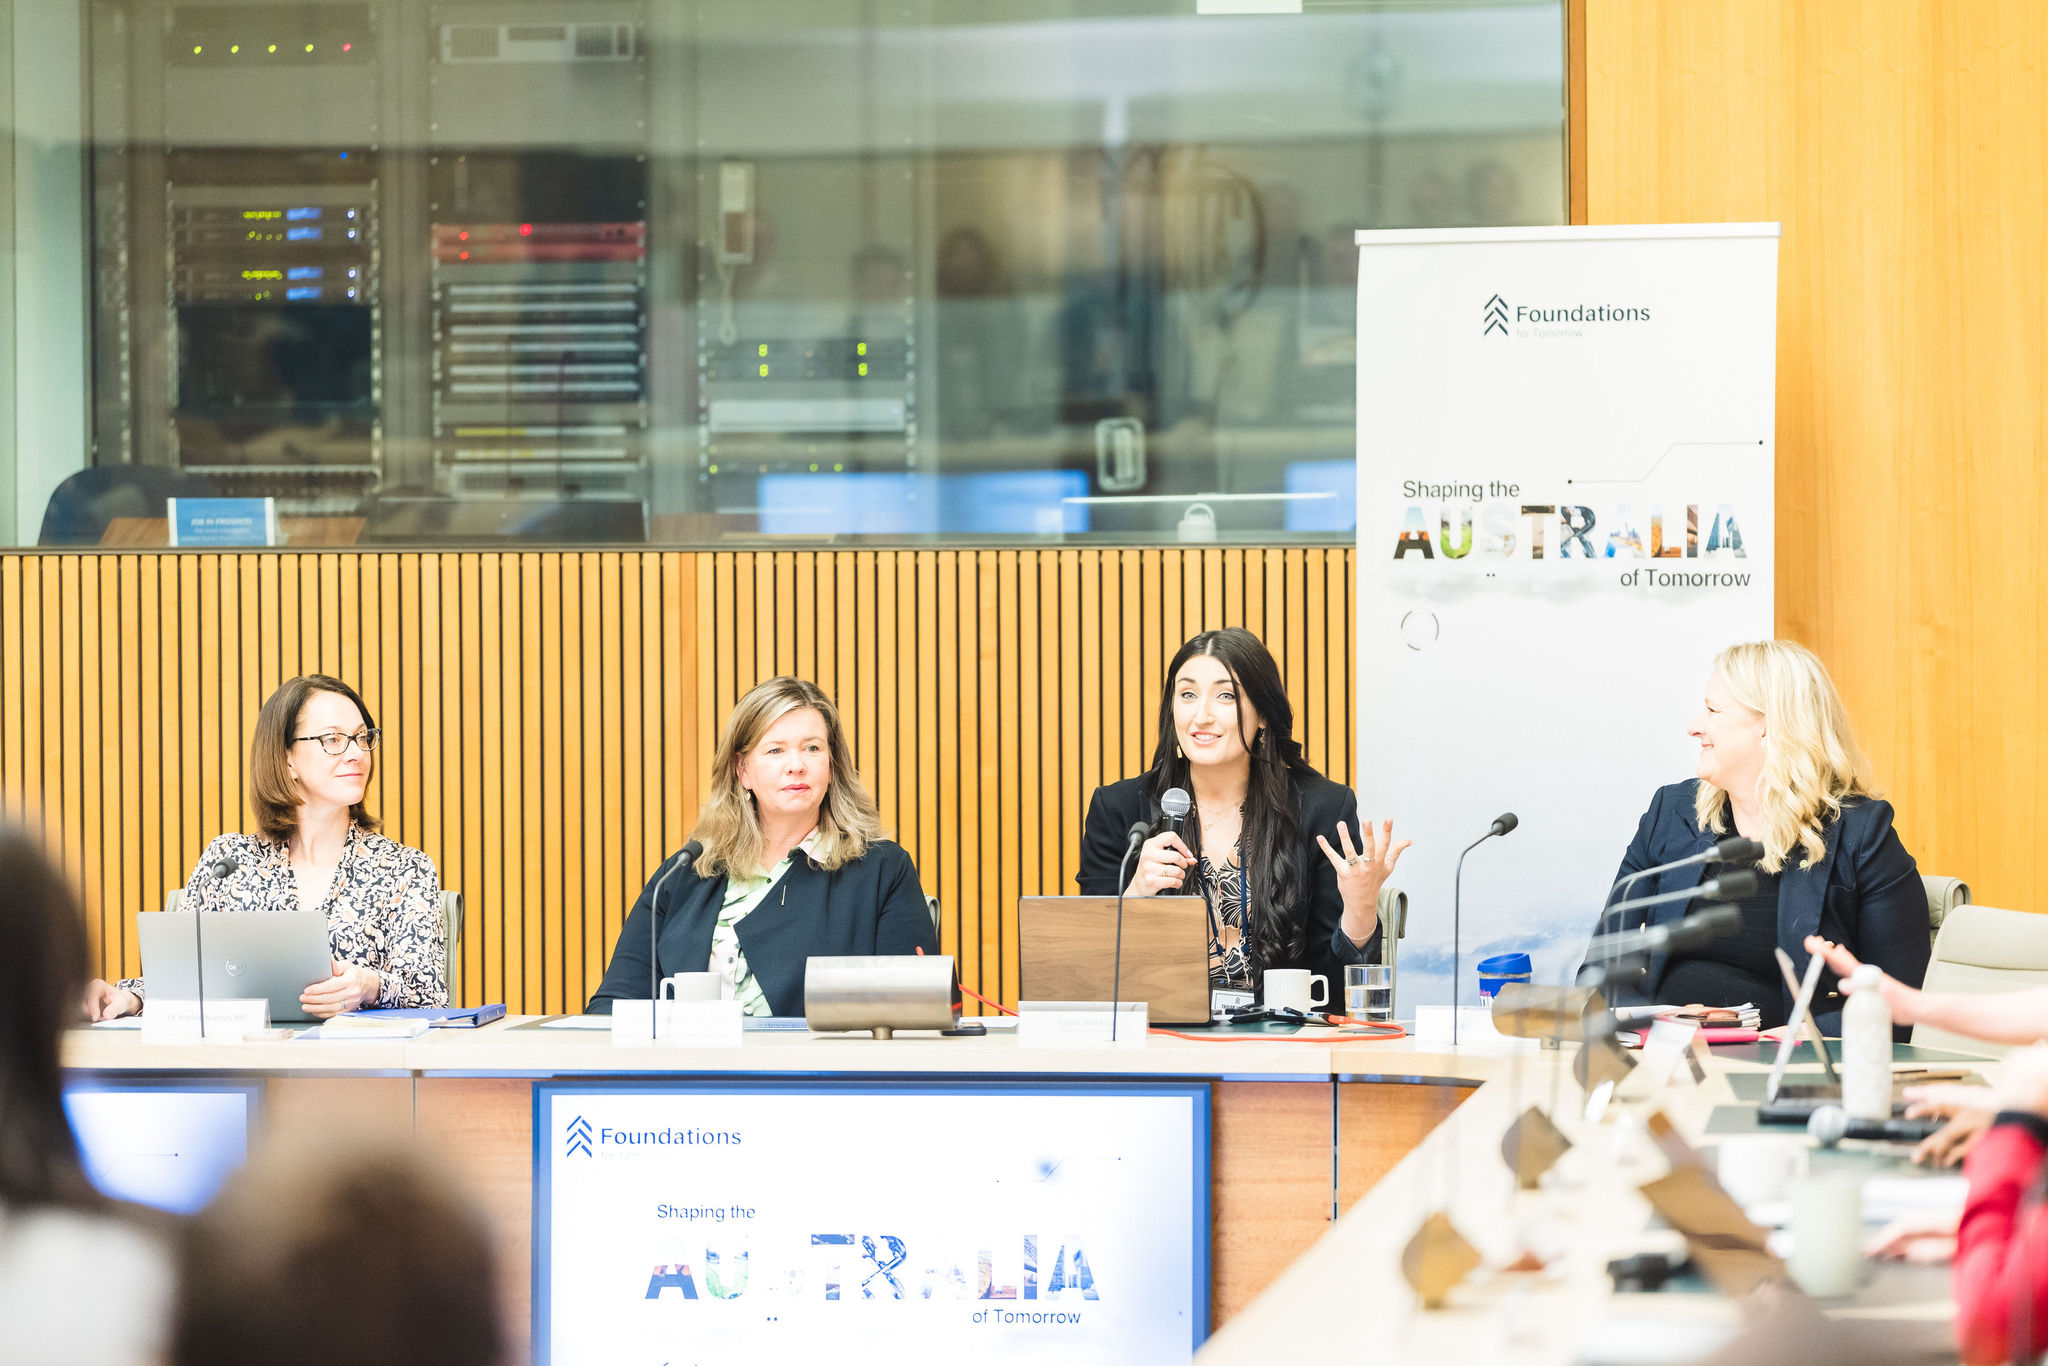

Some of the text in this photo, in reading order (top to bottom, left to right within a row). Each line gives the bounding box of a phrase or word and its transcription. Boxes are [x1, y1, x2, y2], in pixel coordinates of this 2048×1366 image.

[1516, 304, 1651, 323] Foundations
[1516, 328, 1584, 339] for Tomorrow
[1403, 480, 1520, 503] Shaping the
[1393, 503, 1748, 560] AUSTRALIA
[1619, 568, 1751, 587] of Tomorrow
[601, 1127, 742, 1145] Foundations
[656, 1204, 756, 1222] Shaping the
[972, 1308, 1081, 1324] of Tomorrow
